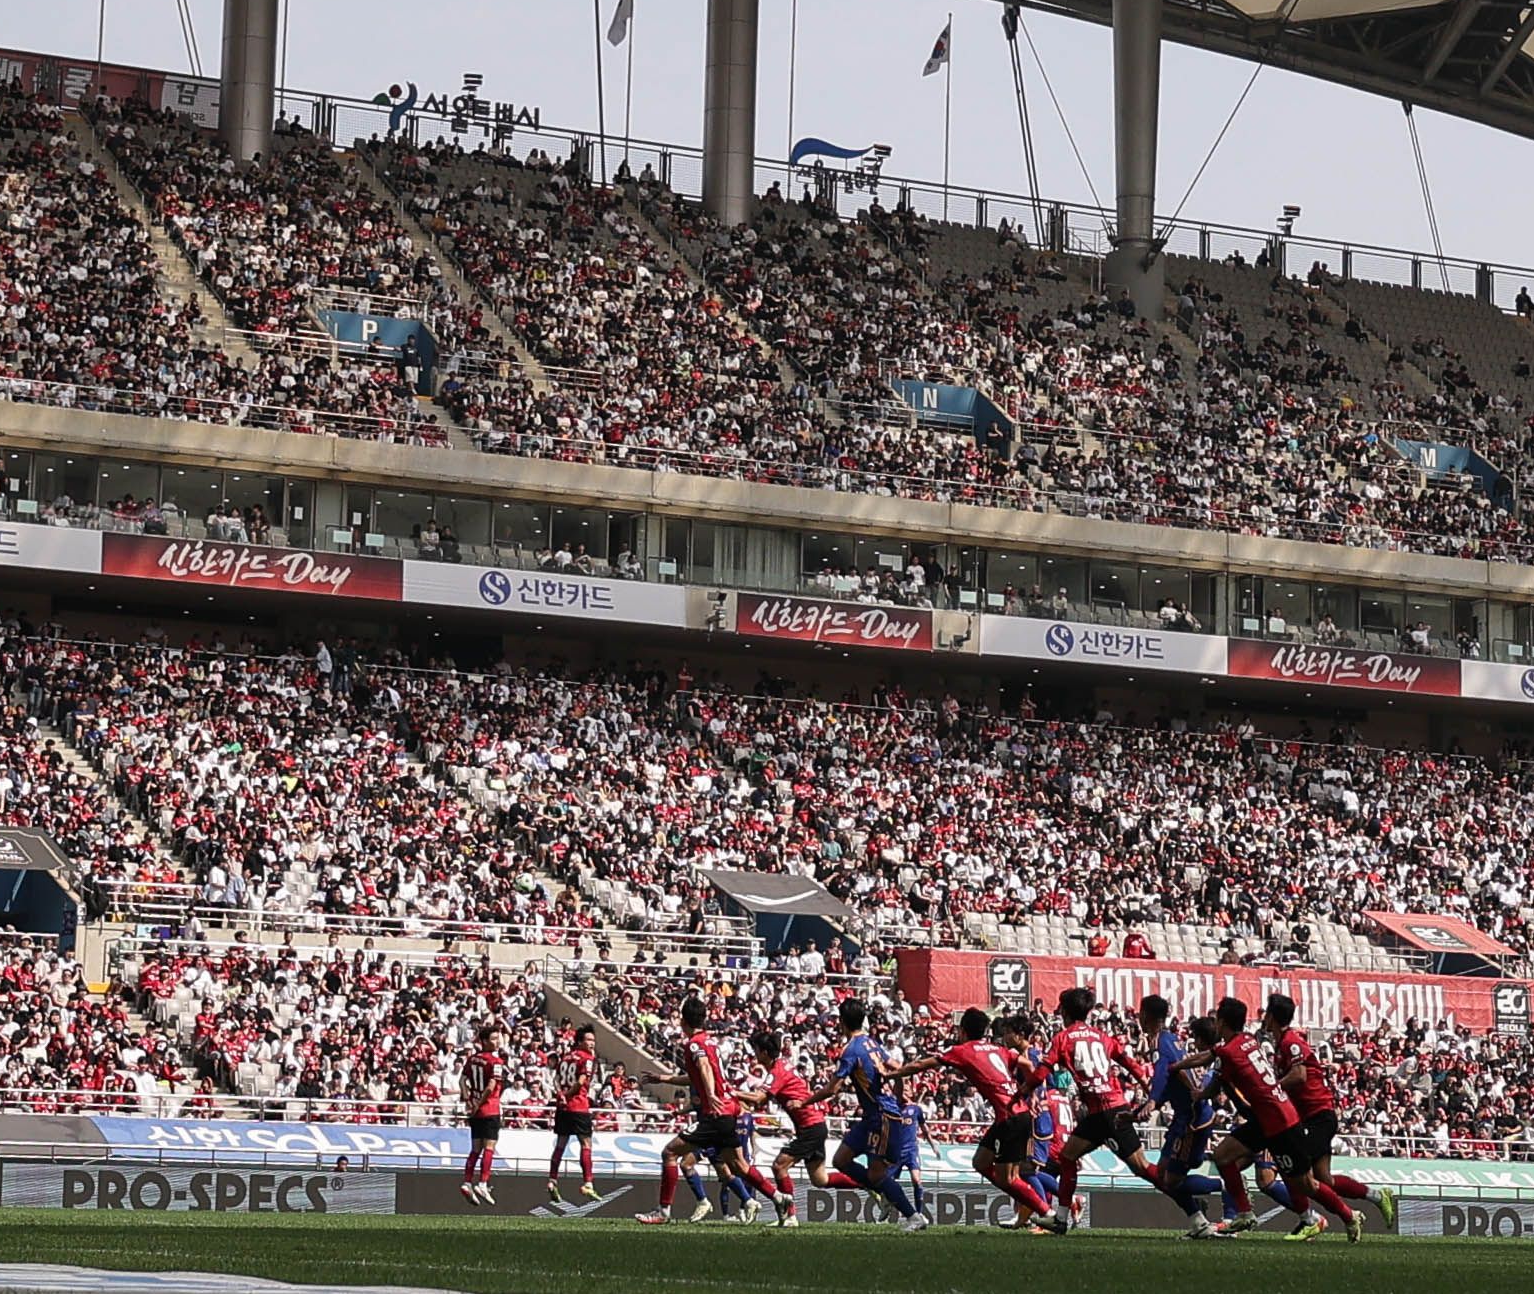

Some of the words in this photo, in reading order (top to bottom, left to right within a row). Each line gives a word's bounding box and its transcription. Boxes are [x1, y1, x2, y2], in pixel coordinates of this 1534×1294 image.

[362, 320, 378, 341] P
[922, 387, 938, 409] N
[1420, 447, 1437, 467] M
[275, 552, 353, 594] Day
[518, 577, 614, 611] 신한카드
[853, 609, 921, 648] Day
[1079, 628, 1164, 661] 신한카드
[1360, 652, 1422, 692] Day
[1074, 1040, 1110, 1082] 40
[470, 1065, 485, 1091] 11
